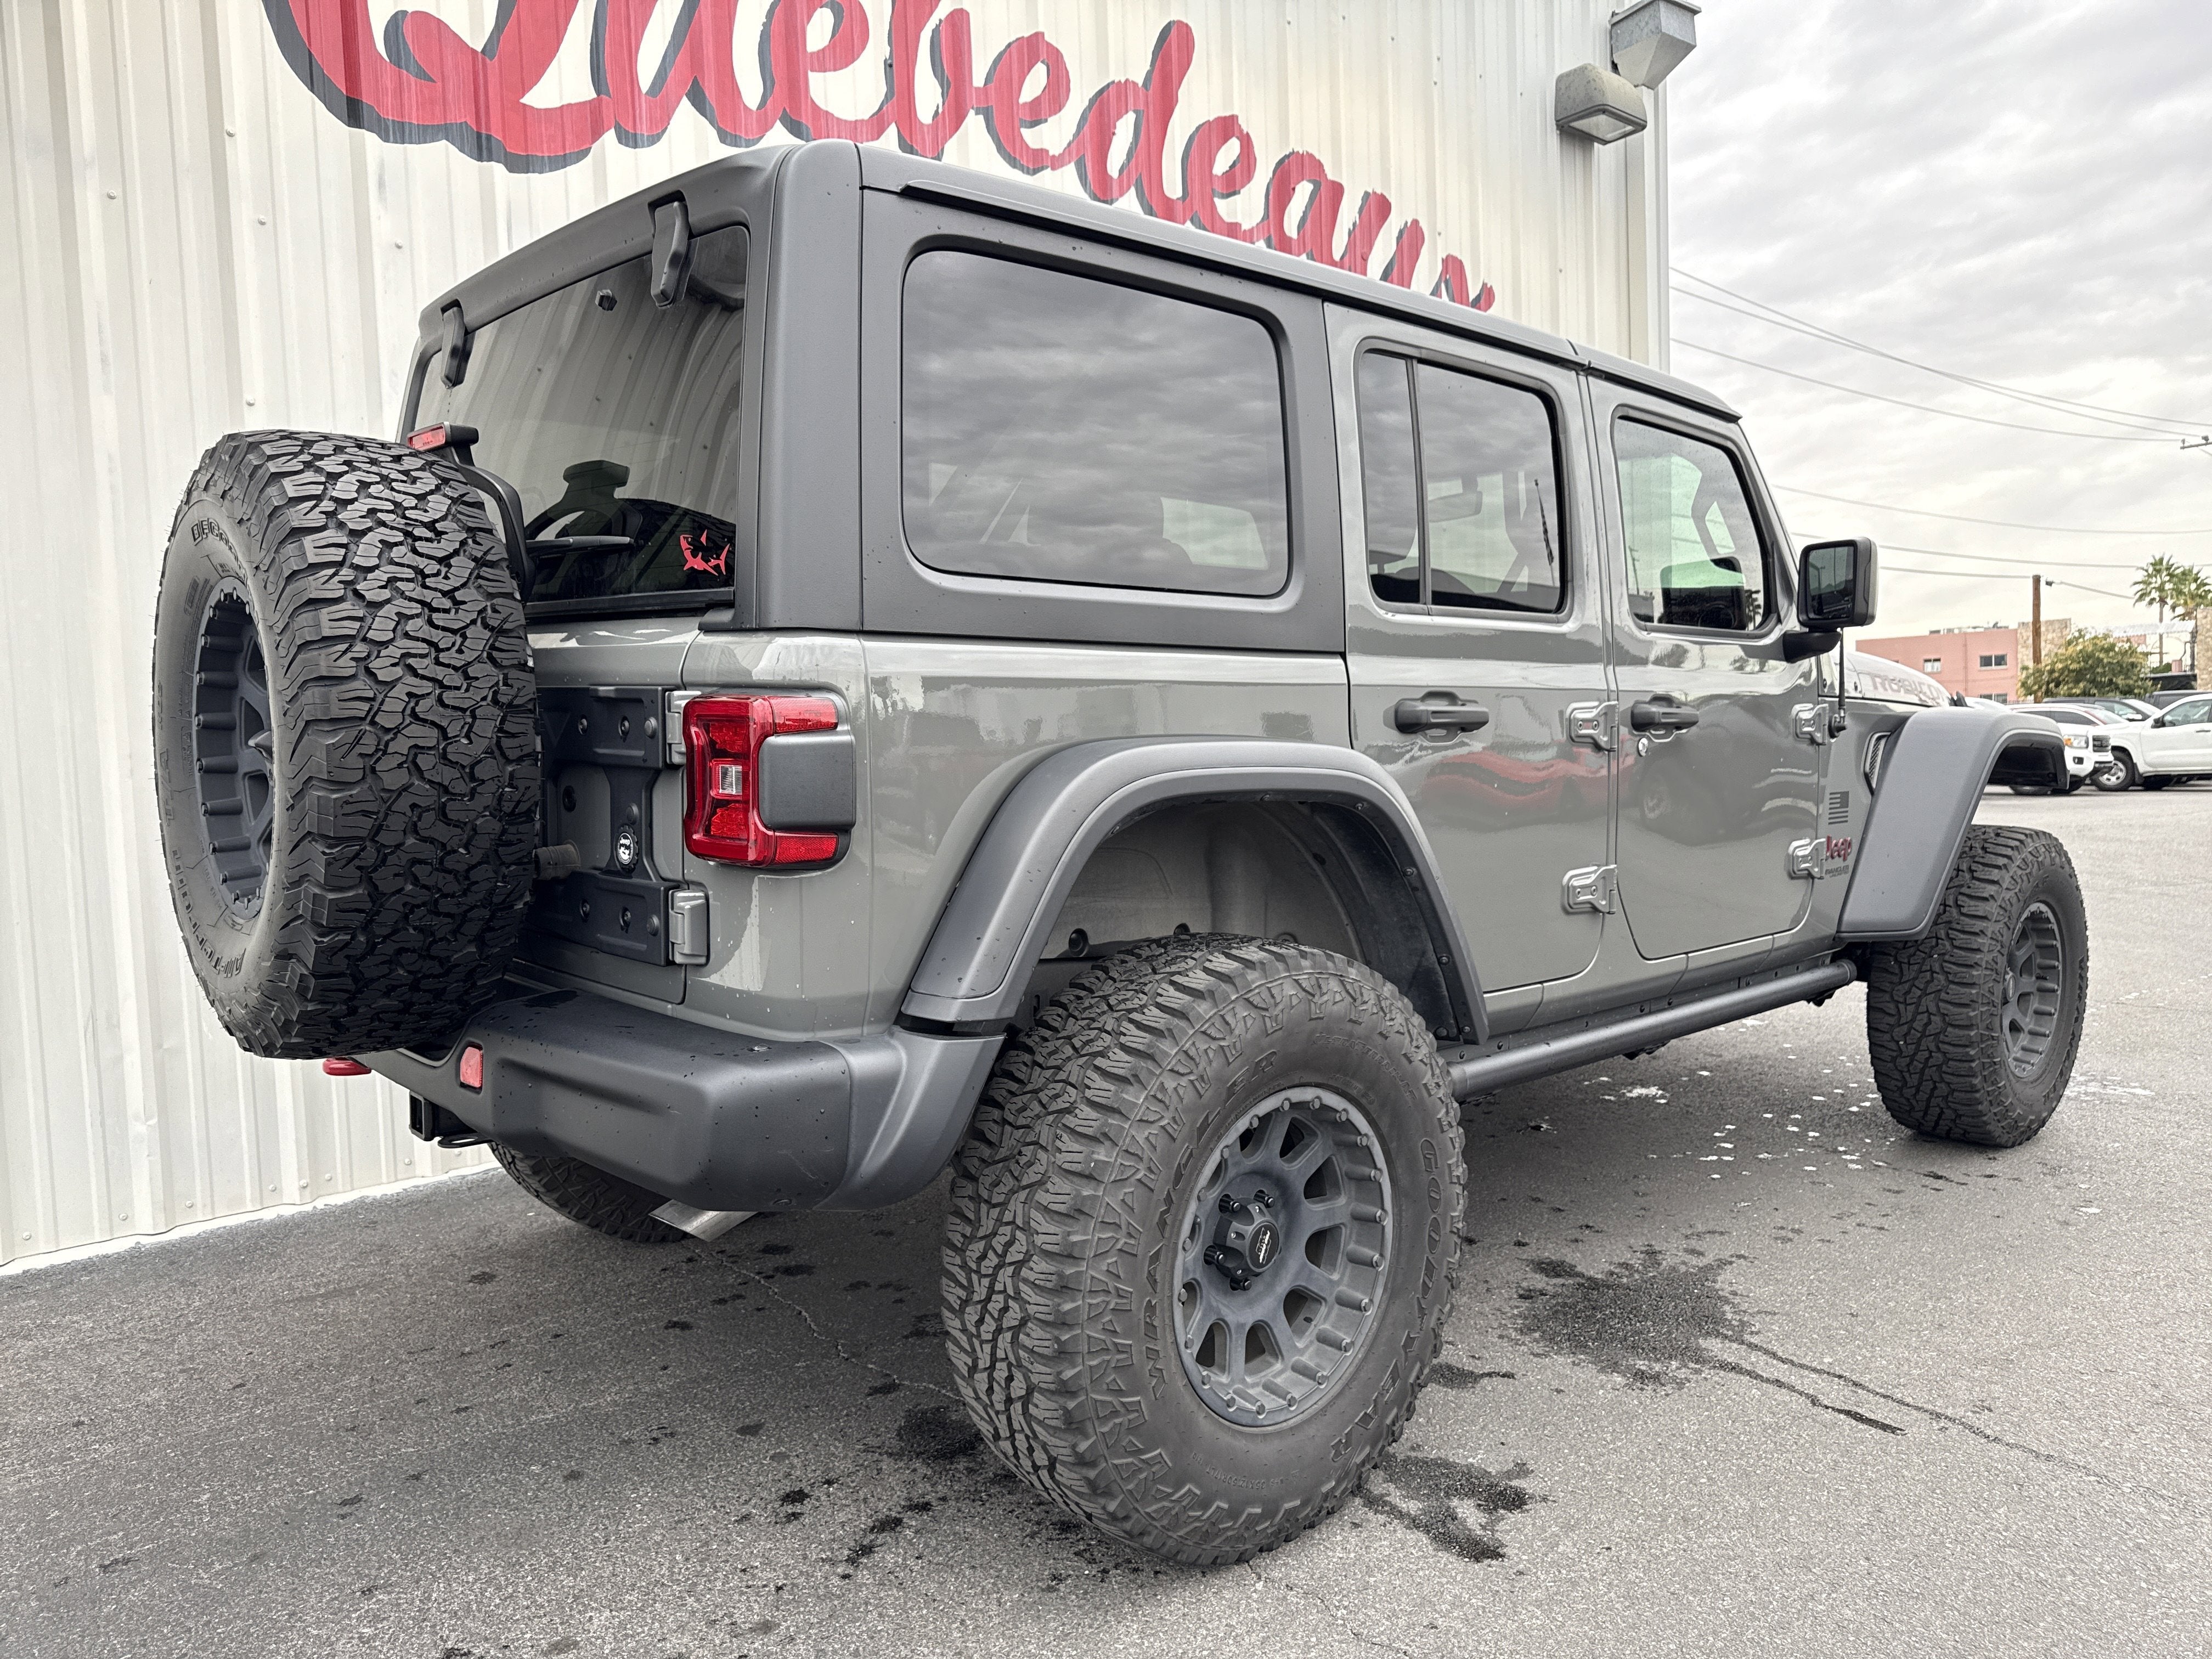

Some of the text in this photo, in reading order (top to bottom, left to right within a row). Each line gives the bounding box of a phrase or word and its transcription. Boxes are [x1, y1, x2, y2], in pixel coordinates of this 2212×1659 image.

[619, 837, 630, 847] Jeep
[1826, 834, 1853, 862] Jeep
[1144, 1048, 1280, 1401] WRANGLER
[1330, 1137, 1441, 1463] GOODYEAR
